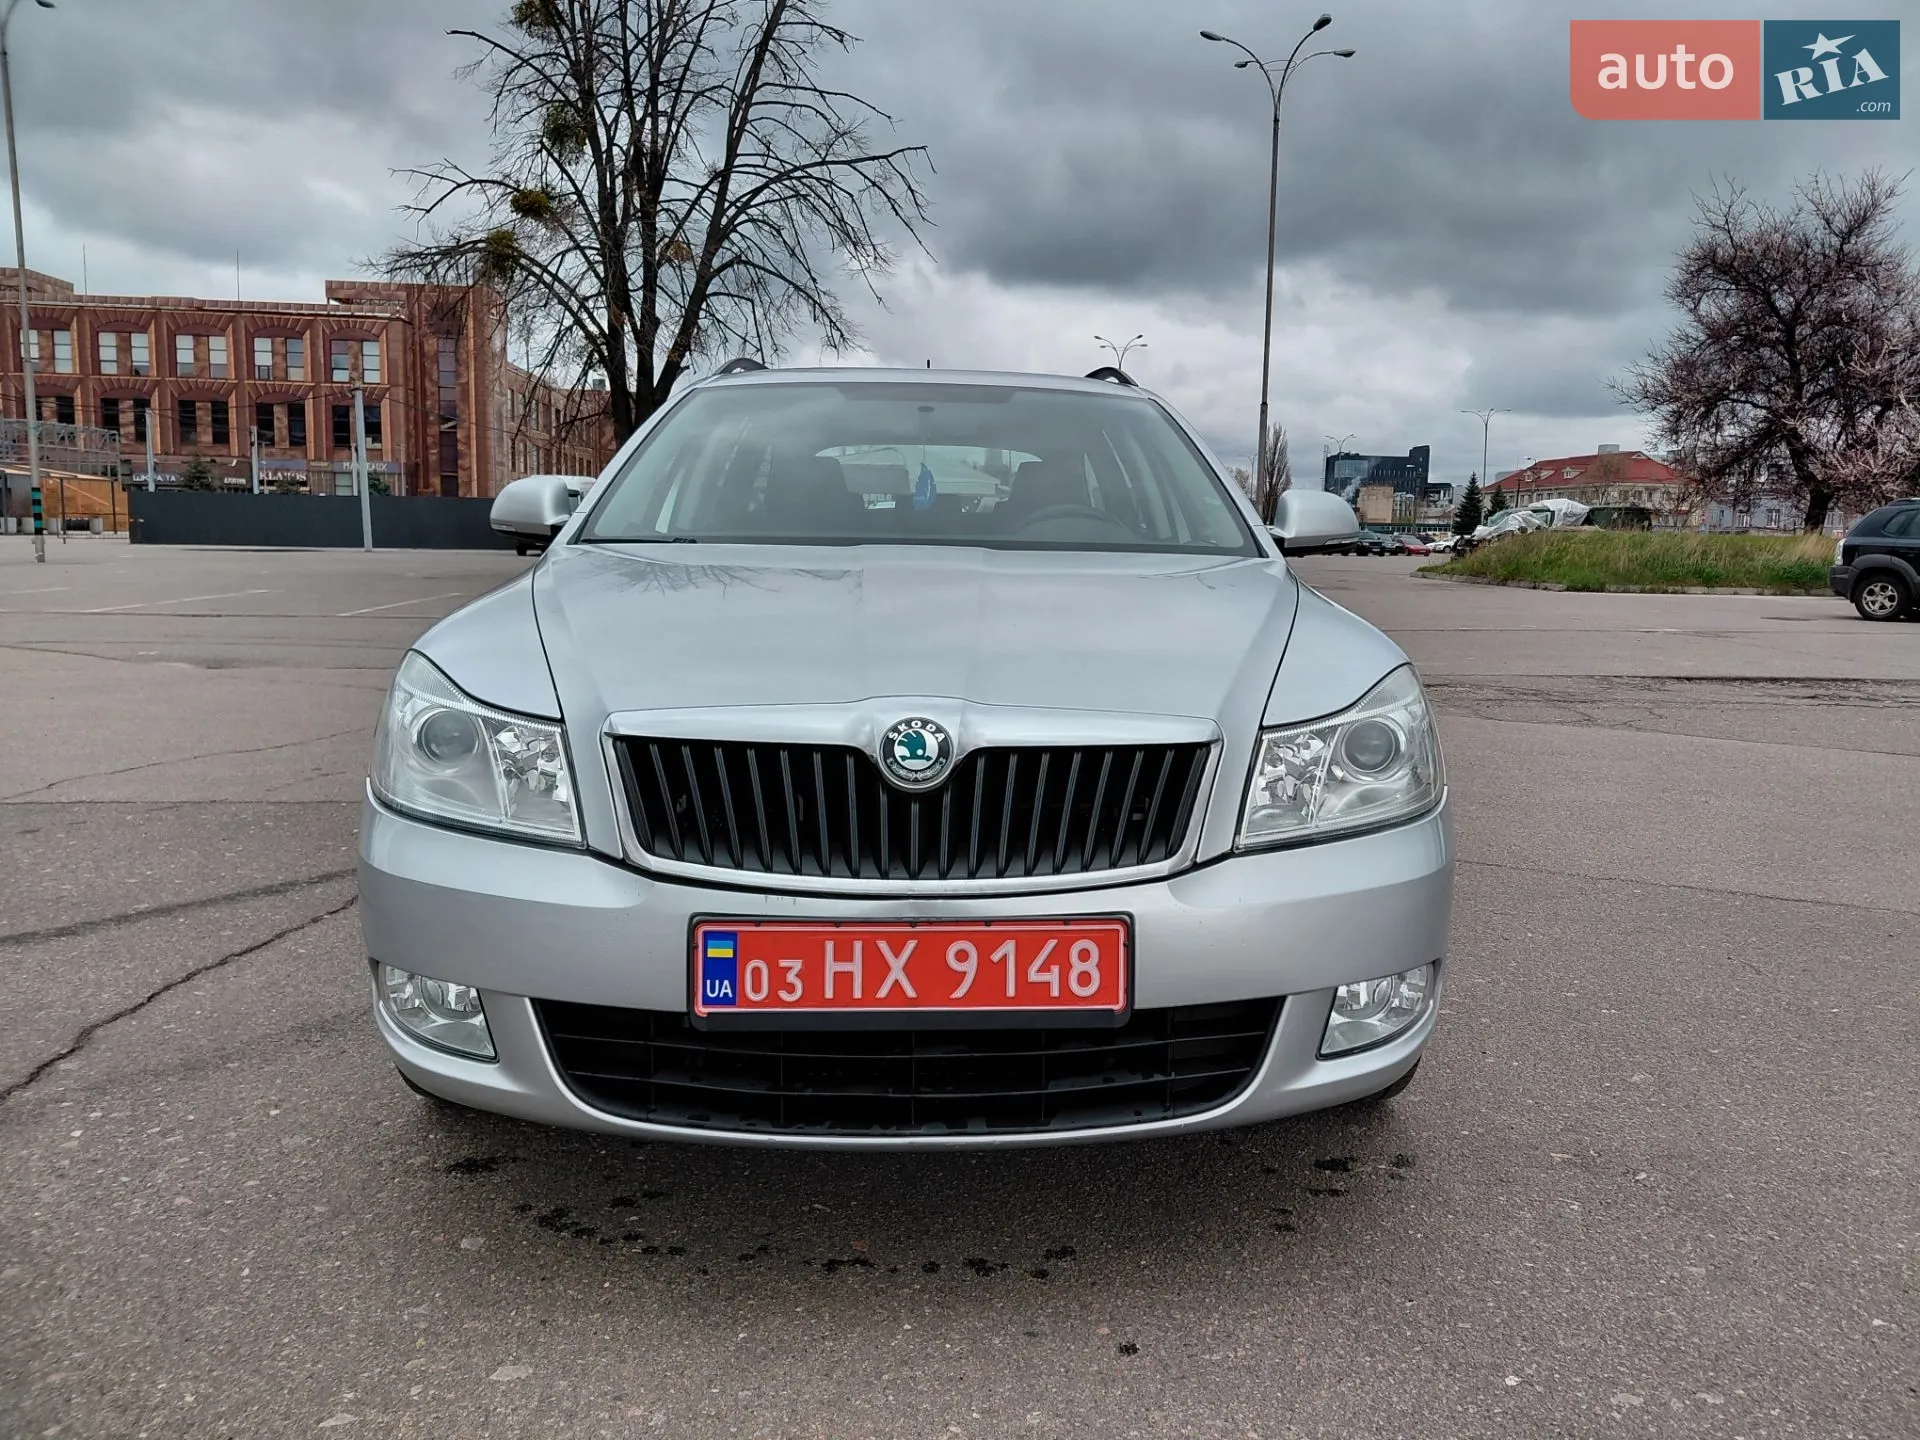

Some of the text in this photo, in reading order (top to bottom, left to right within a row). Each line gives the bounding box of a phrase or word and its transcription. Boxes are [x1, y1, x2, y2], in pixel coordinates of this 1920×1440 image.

[705, 979, 734, 999] UA
[743, 938, 1101, 1003] 03 HX 9148
